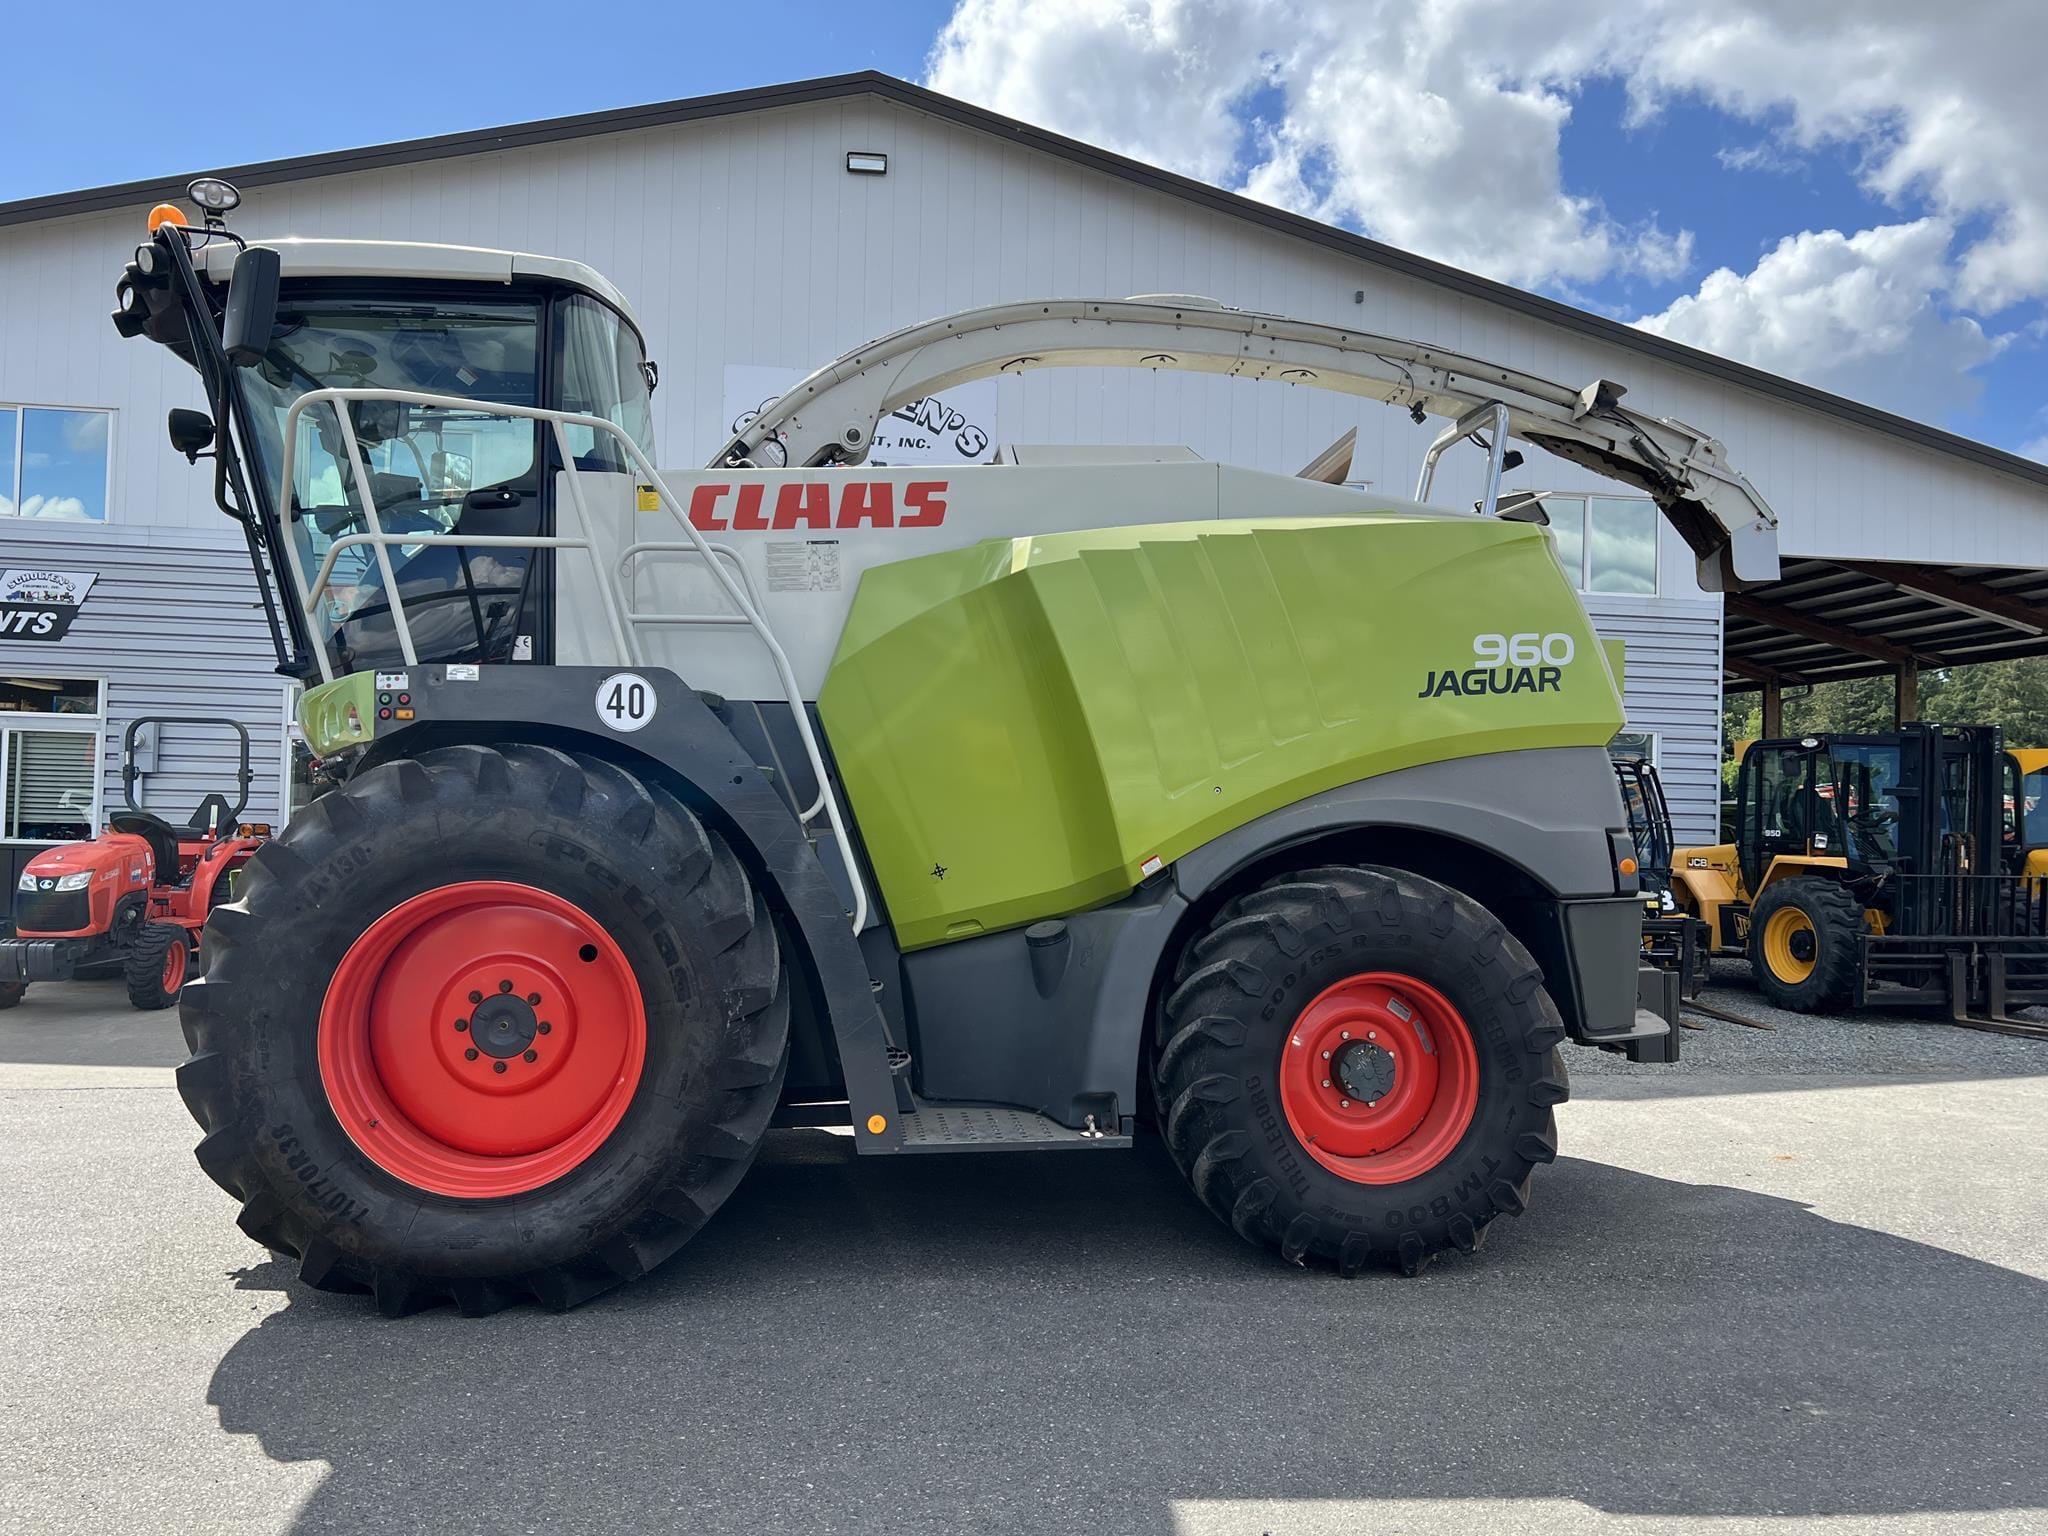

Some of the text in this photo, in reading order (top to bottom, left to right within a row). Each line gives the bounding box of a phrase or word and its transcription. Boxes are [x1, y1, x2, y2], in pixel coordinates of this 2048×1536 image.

[898, 437, 931, 449] INC.
[688, 481, 949, 531] CLAAS
[6, 572, 76, 592] SCHOLTEN'S
[1473, 632, 1575, 668] 960
[1418, 667, 1562, 698] JAGUAR
[606, 683, 645, 720] 40
[1687, 858, 1708, 868] JCB
[1246, 1074, 1312, 1201] TRELLEBORG
